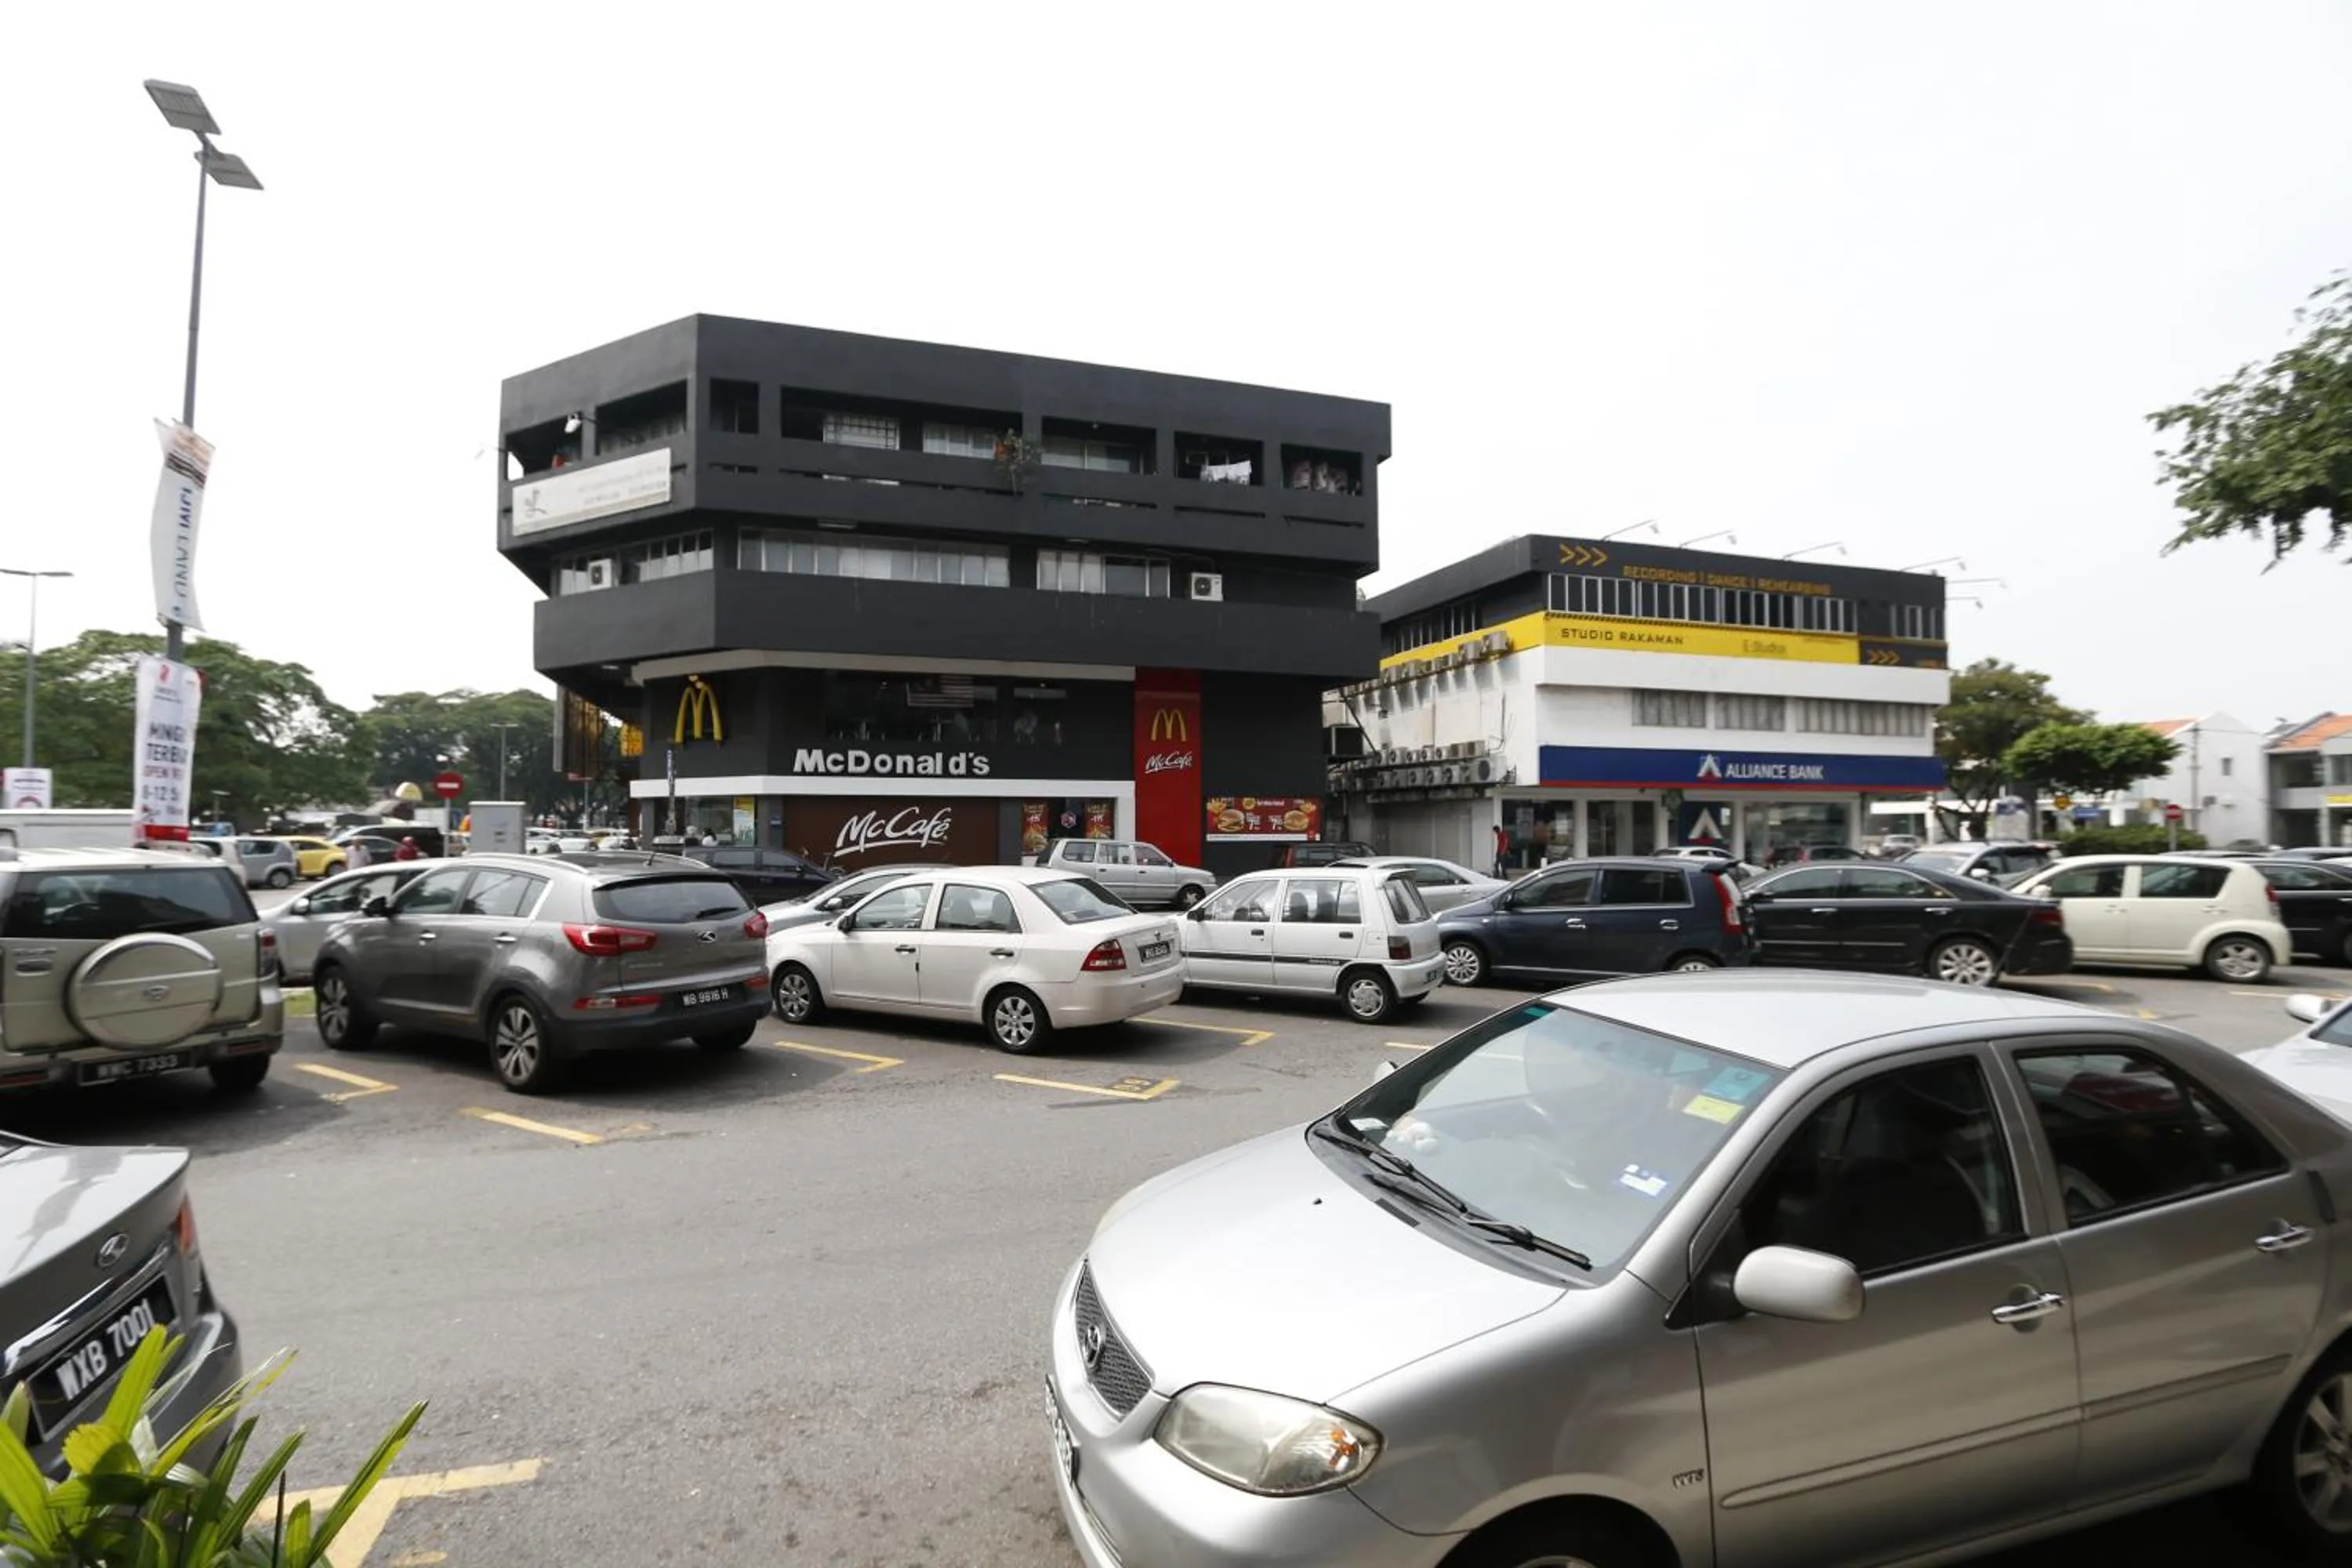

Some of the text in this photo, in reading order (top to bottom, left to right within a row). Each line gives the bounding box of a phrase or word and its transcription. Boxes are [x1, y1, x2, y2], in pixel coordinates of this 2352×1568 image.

[1561, 628, 1684, 645] STUDIO RAKAMAN
[793, 748, 991, 776] McDonald's
[1725, 763, 1824, 780] ALLIANCE BANK
